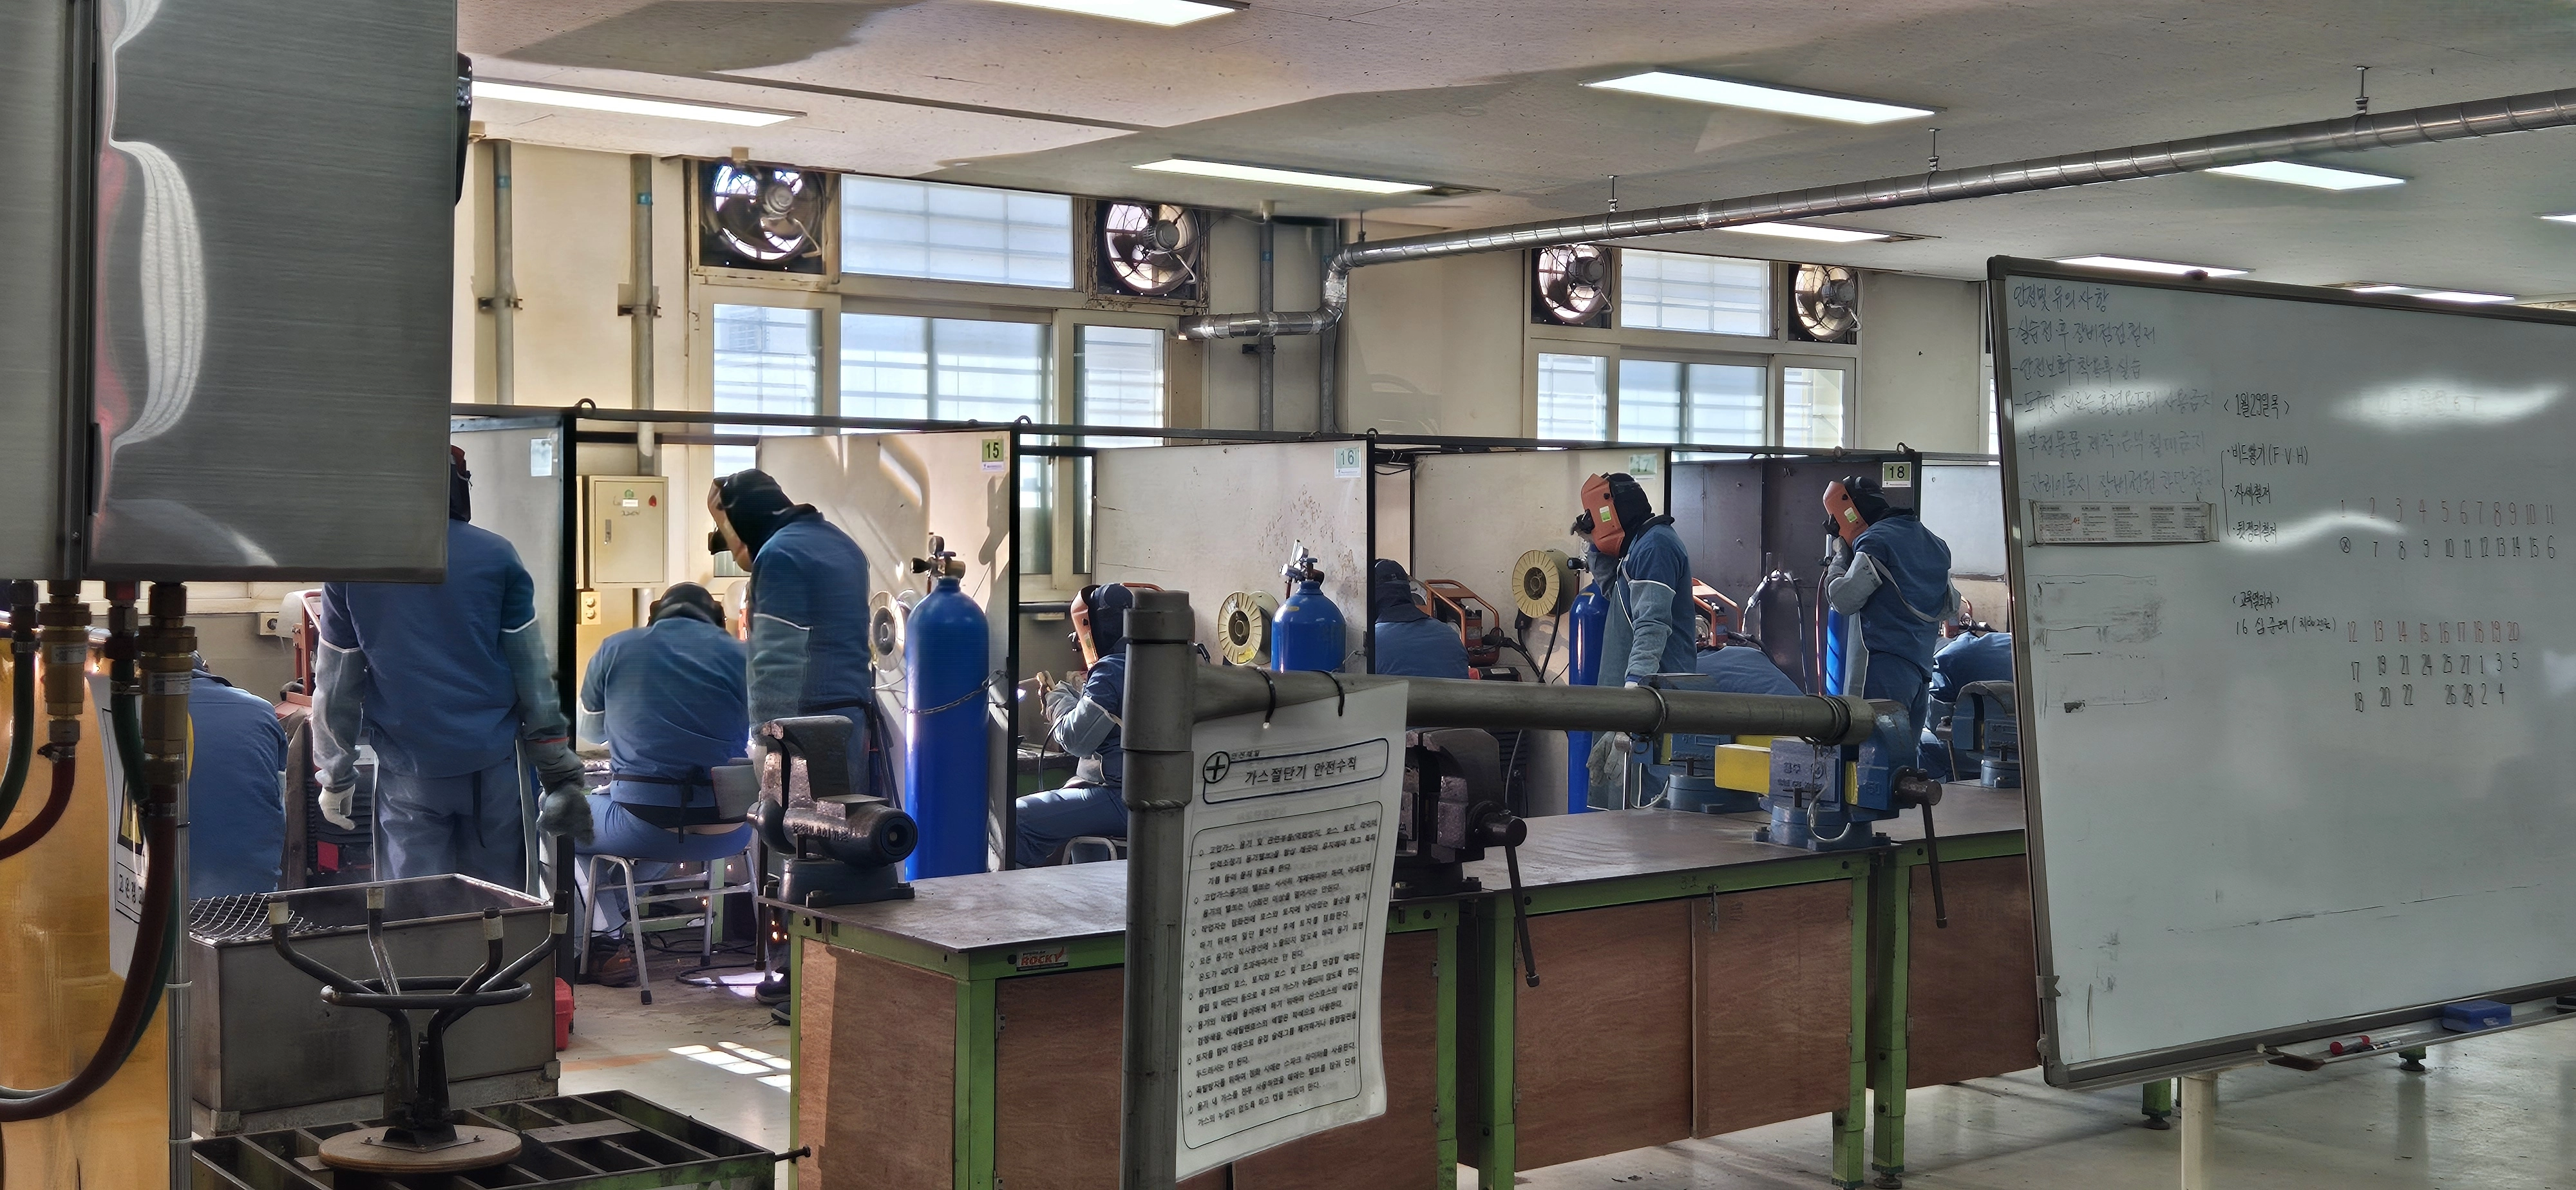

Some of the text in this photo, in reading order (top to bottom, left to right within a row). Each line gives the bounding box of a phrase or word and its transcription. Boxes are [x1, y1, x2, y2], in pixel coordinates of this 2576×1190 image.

[986, 442, 999, 458] 15
[1341, 450, 1354, 465] 16
[1636, 458, 1650, 472] 17
[1889, 466, 1904, 478] 18
[2396, 498, 2402, 522] 3
[2419, 498, 2427, 524] 4
[2441, 500, 2448, 522] 5
[2460, 500, 2467, 524] 6
[2476, 501, 2483, 524] 7
[2494, 502, 2501, 527] 8
[2508, 502, 2516, 525] 9
[2525, 504, 2536, 525] 10
[2546, 504, 2554, 525] 11
[2373, 541, 2378, 558] 7
[2398, 541, 2406, 560] 8
[2423, 539, 2429, 558] 9
[2445, 538, 2454, 558] 10
[2497, 537, 2505, 556] 13
[2529, 536, 2539, 558] 15
[2548, 535, 2555, 559] 6
[2237, 618, 2248, 634] 16
[2347, 621, 2358, 642] 12
[2374, 620, 2383, 641] 13
[2507, 621, 2519, 641] 20
[2480, 655, 2484, 674] 1
[2496, 652, 2503, 672] 3
[2512, 652, 2519, 669] 5
[2481, 683, 2488, 704] 2
[2499, 683, 2505, 704] 4
[1245, 764, 1307, 785] 가스절단기
[1021, 947, 1065, 965] ROCKY
